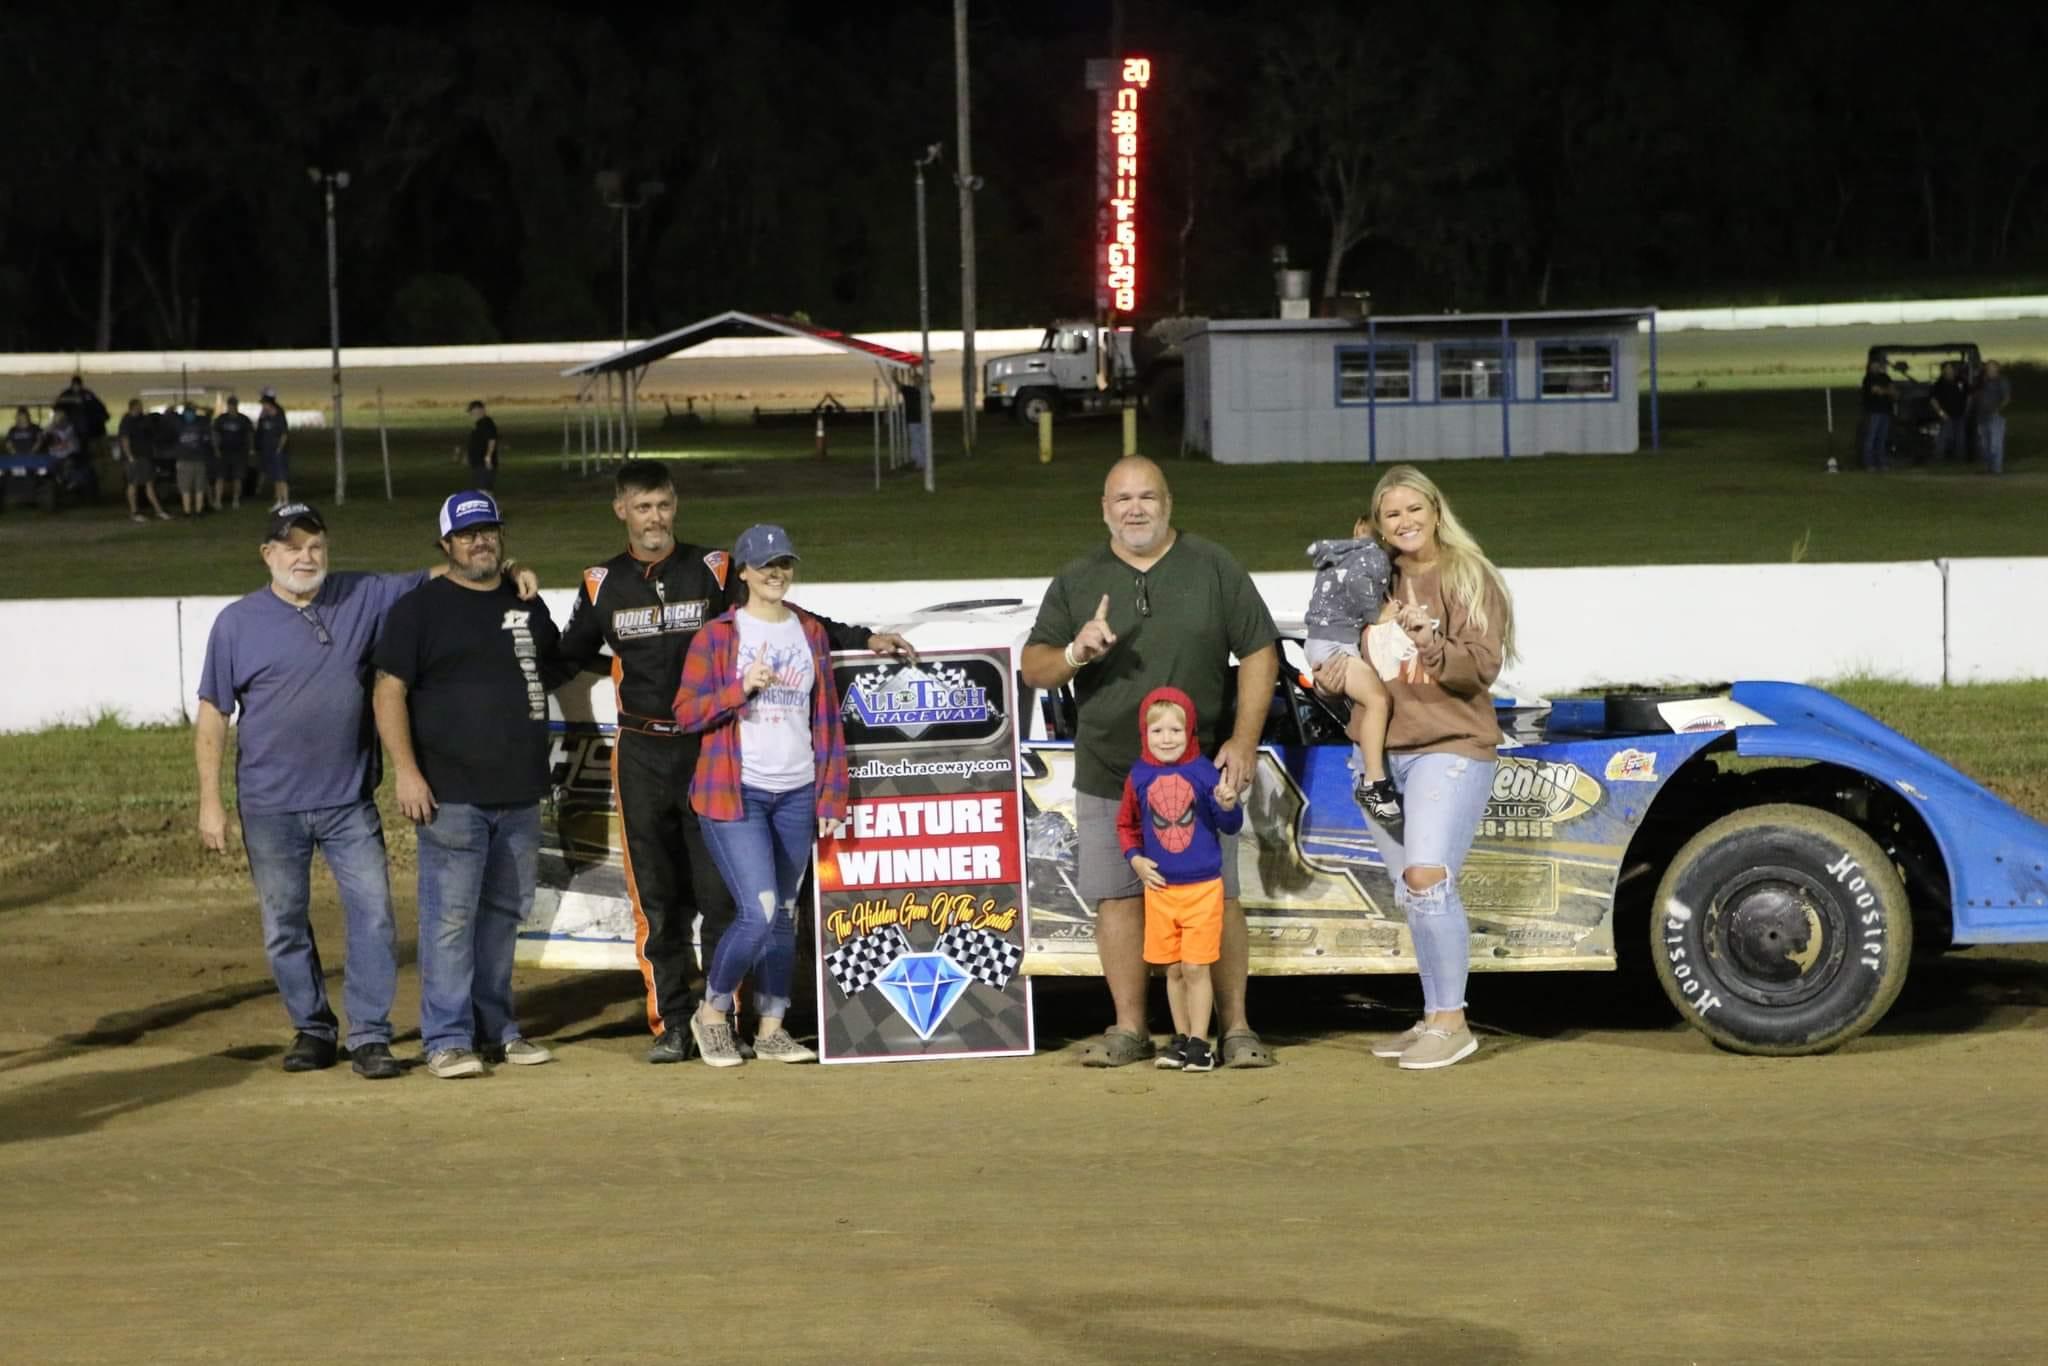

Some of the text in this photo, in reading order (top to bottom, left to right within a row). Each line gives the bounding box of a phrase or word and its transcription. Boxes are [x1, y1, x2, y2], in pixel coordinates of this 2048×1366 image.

[615, 609, 653, 628] DONE
[664, 603, 705, 621] RIGHT
[755, 687, 808, 707] PRESIDEN
[908, 679, 986, 711] TECH
[873, 706, 981, 724] RACEWAY
[848, 758, 1011, 778] w.alltechraceway.com
[1491, 758, 1577, 814] enny
[833, 798, 1004, 840] FEATURE
[1498, 806, 1541, 817] LUBE
[836, 844, 1002, 886] WINNER
[827, 892, 1017, 945] The Hidden Gem Of The South
[1663, 898, 1722, 1017] Hoosie
